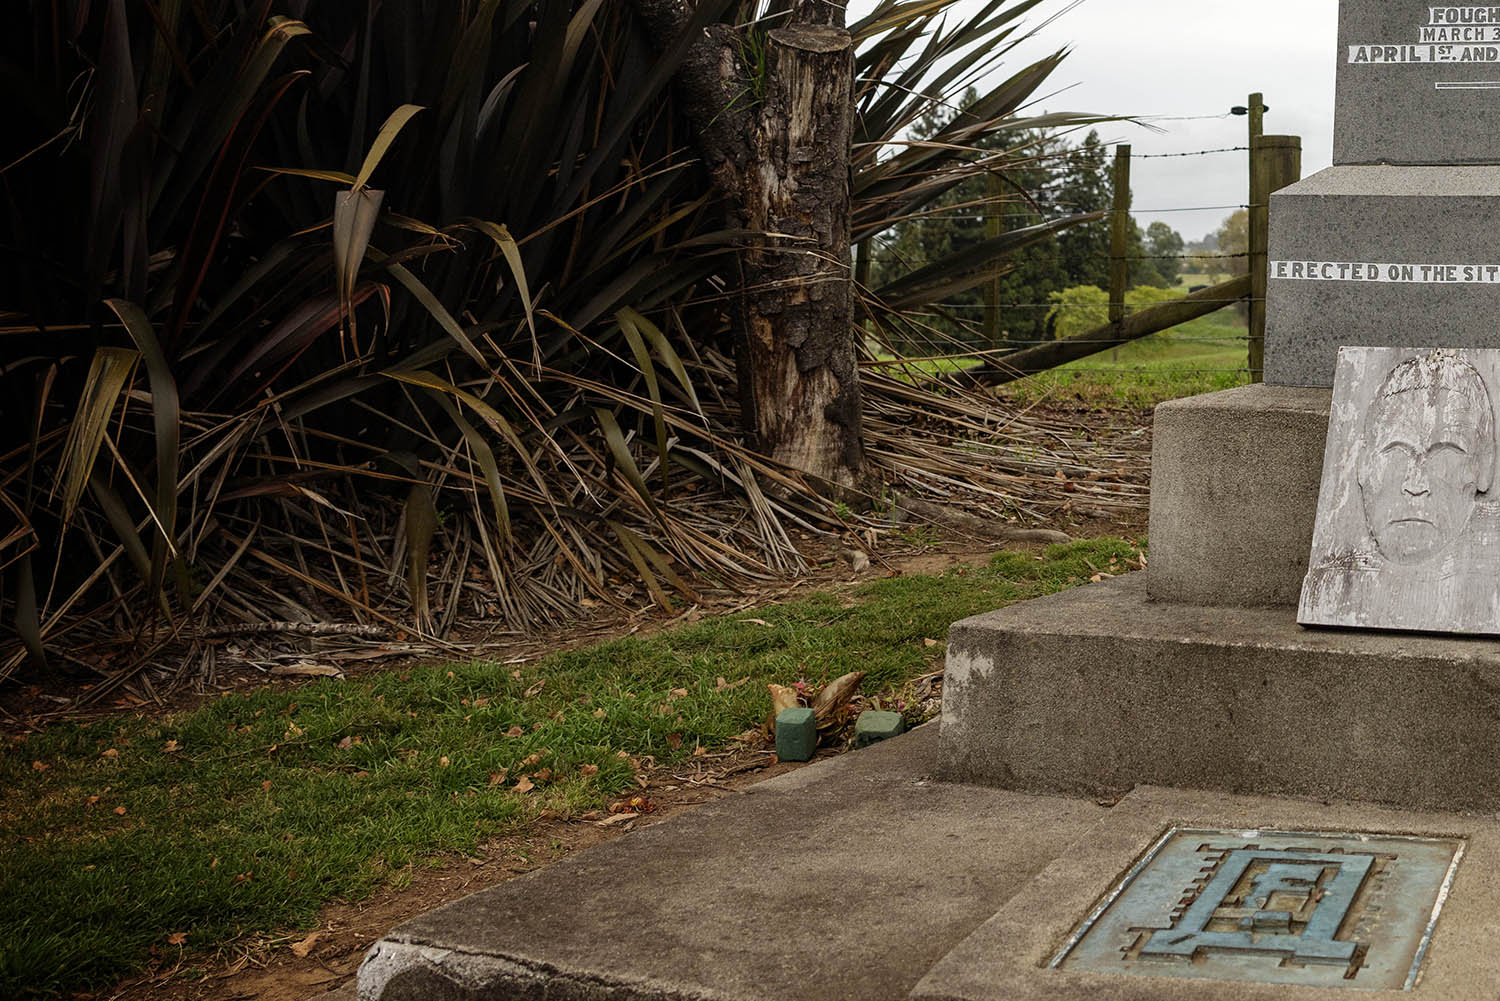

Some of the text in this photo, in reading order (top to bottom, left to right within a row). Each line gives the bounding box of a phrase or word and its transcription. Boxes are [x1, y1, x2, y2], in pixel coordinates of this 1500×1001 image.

[1423, 27, 1485, 42] MARCH
[1354, 46, 1421, 62] APRIL
[1460, 47, 1498, 62] AND
[1276, 262, 1379, 280] ERECTED
[1388, 265, 1414, 281] ON
[1420, 265, 1459, 282] THE
